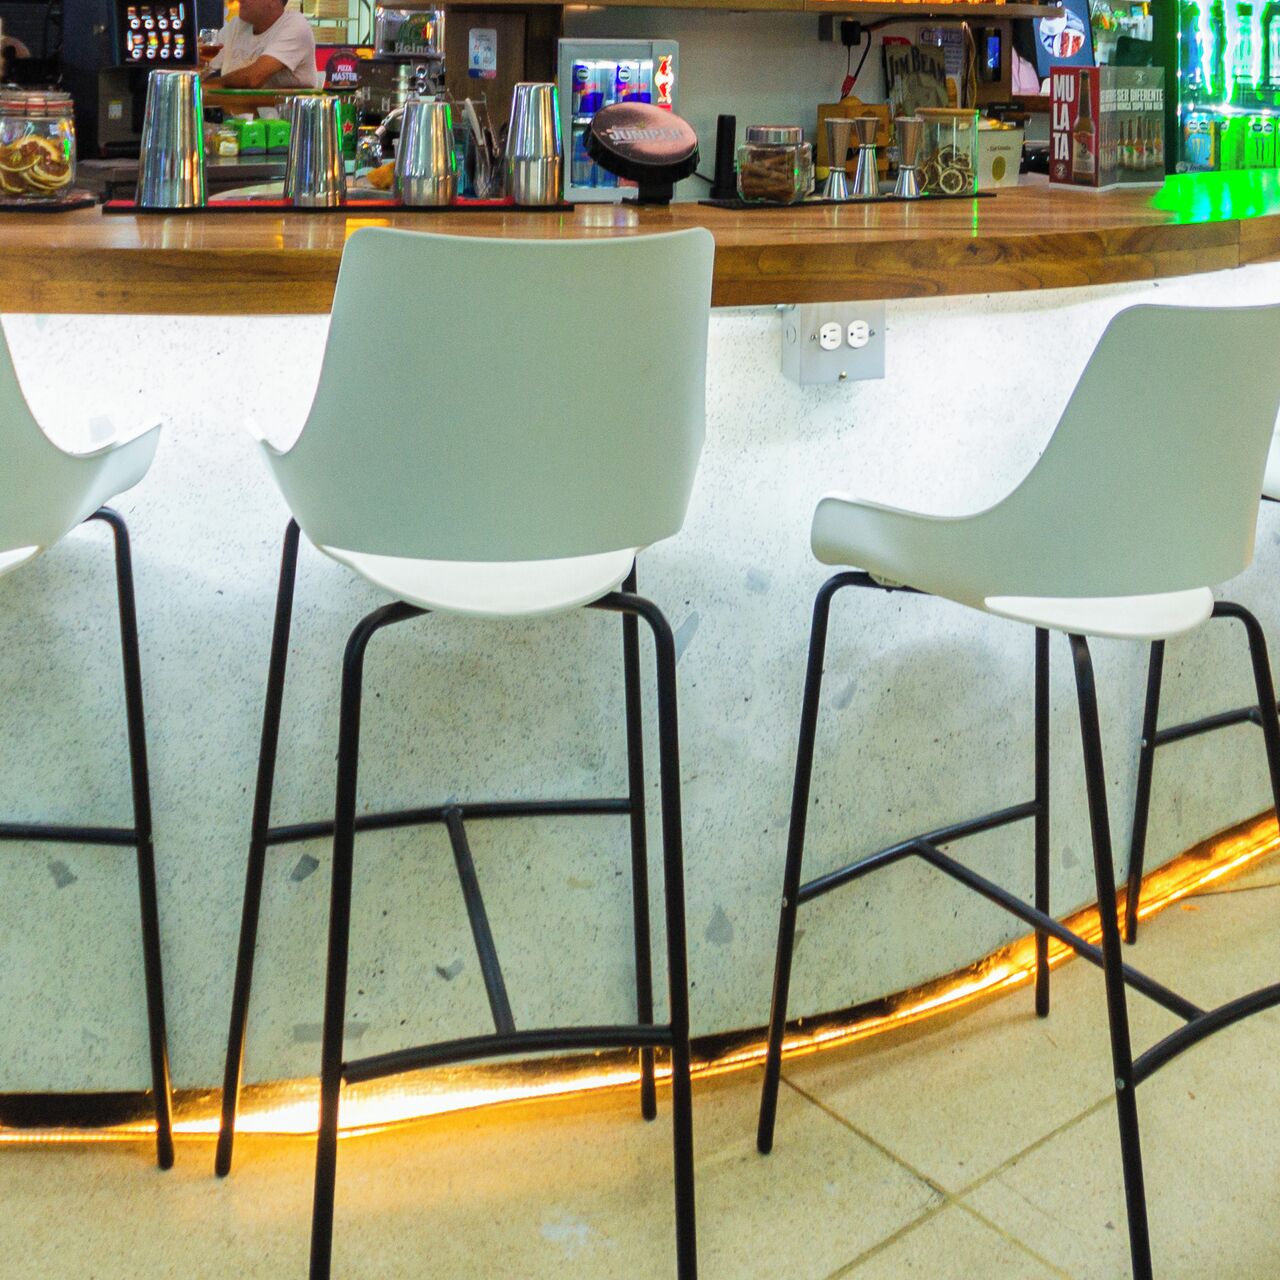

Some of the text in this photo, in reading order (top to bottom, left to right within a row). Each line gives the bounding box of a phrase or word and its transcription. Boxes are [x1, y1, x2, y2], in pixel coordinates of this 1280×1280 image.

[331, 72, 358, 81] MASTER
[337, 64, 353, 72] PIZZA
[1053, 74, 1074, 103] MU
[1053, 103, 1070, 131] LA
[1052, 132, 1070, 161] TA
